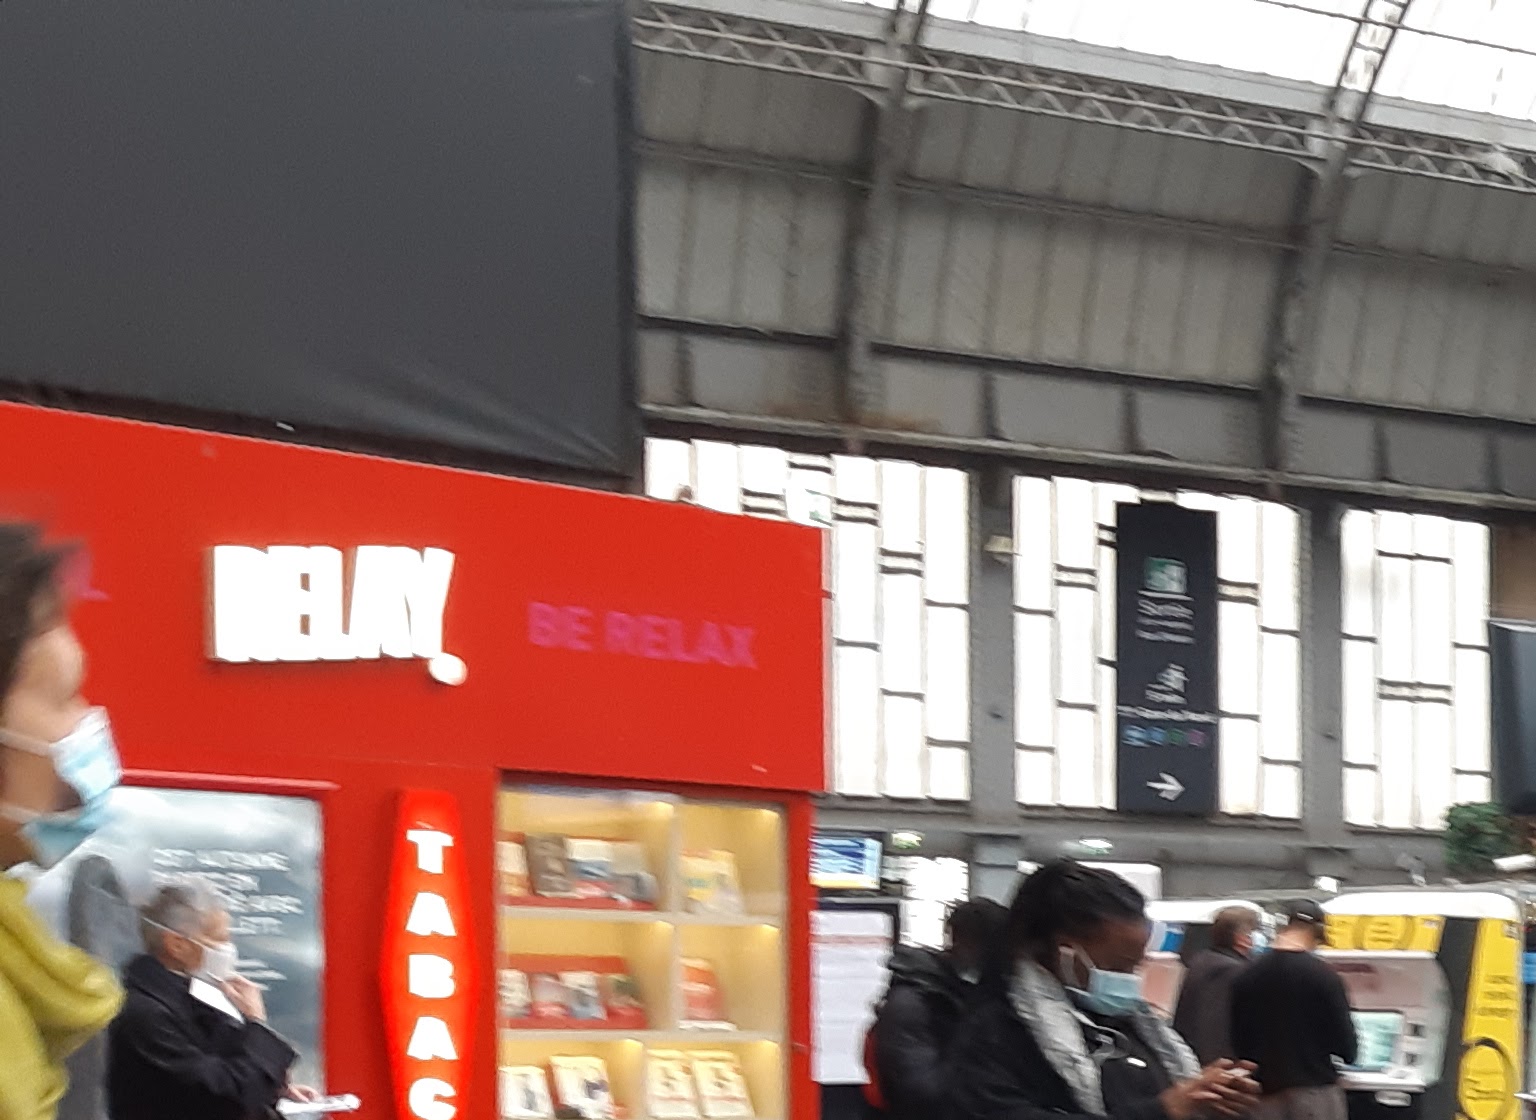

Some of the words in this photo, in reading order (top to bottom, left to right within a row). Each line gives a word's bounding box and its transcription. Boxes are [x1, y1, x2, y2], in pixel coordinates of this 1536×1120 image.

[206, 544, 456, 662] RELAY
[527, 601, 594, 652] BE
[604, 609, 758, 669] RELAX
